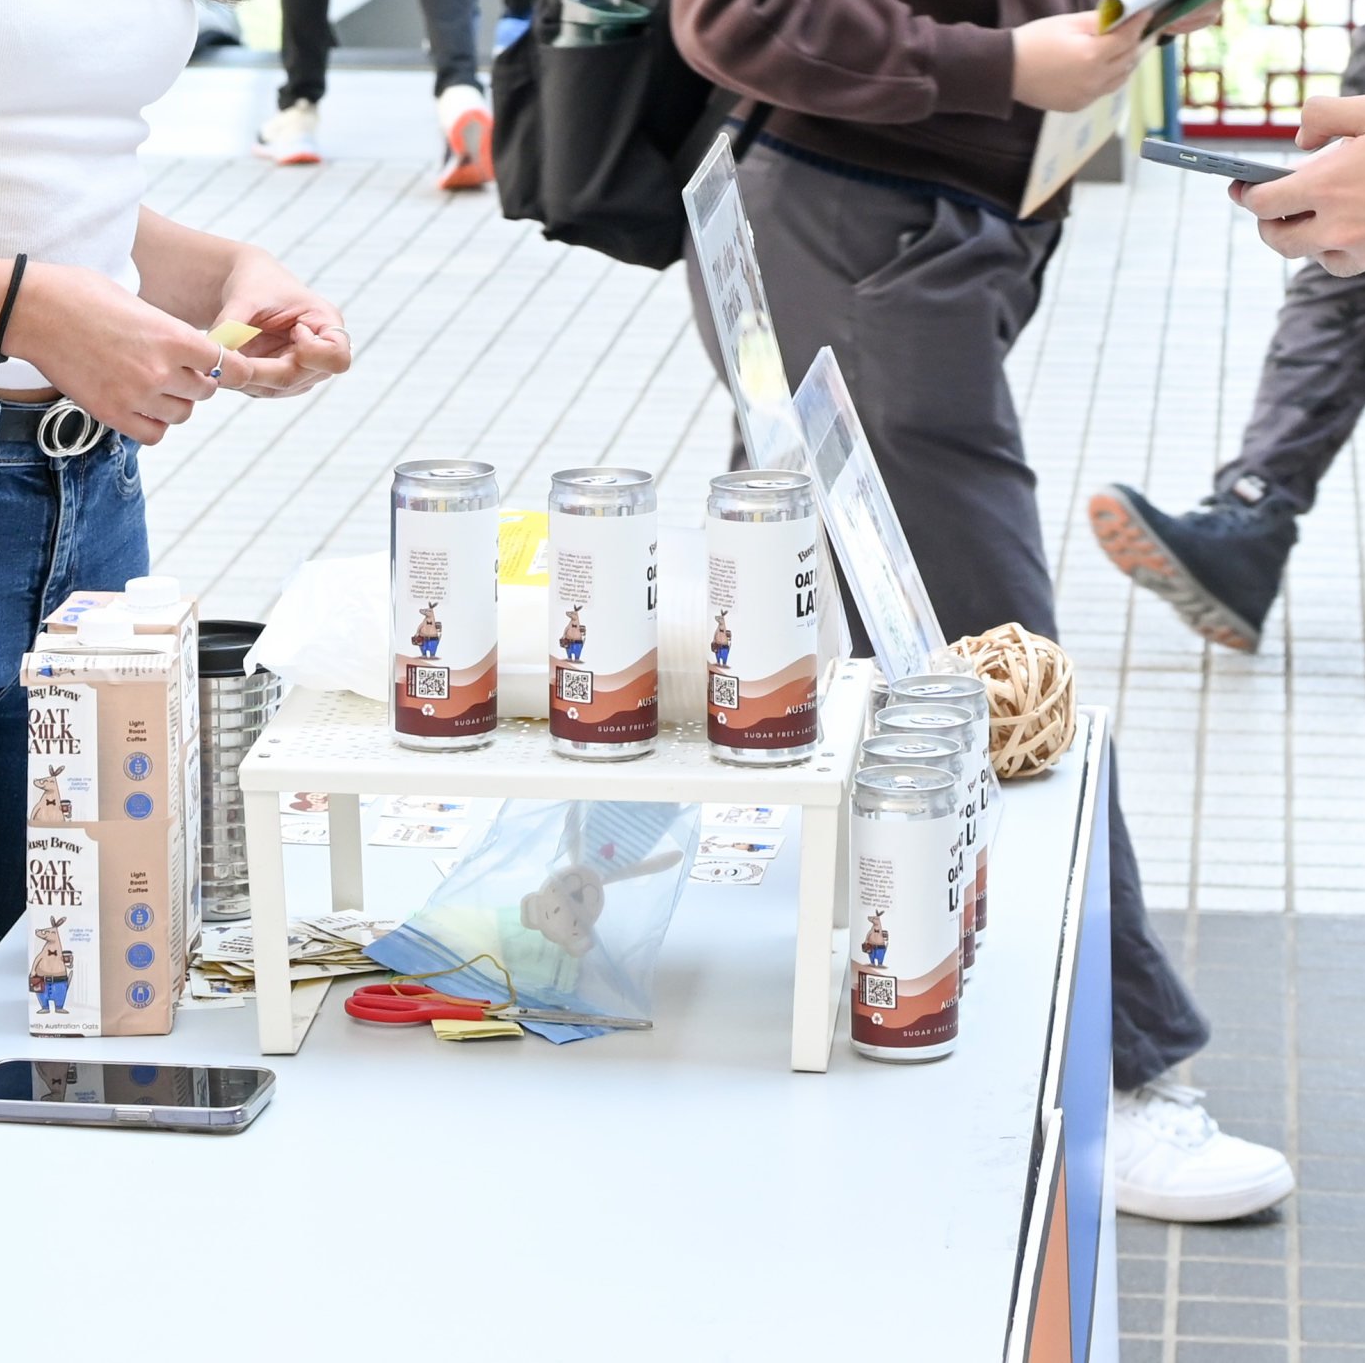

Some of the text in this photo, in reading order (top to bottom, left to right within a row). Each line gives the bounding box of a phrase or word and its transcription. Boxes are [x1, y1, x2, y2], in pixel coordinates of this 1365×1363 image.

[49, 685, 81, 702] Brew
[28, 708, 70, 724] OAT
[454, 719, 480, 727] SUGAR
[129, 720, 145, 728] Light
[597, 723, 645, 733] SUGAR FREE
[28, 724, 75, 740] MILK
[777, 729, 795, 738] FREE
[28, 739, 81, 754] ATTE
[50, 837, 83, 854] Brew
[29, 859, 71, 875] OAT
[29, 875, 75, 891] MILK
[45, 1022, 81, 1030] Australian
[81, 1022, 99, 1030] Oats
[903, 1029, 931, 1037] SUGAR
